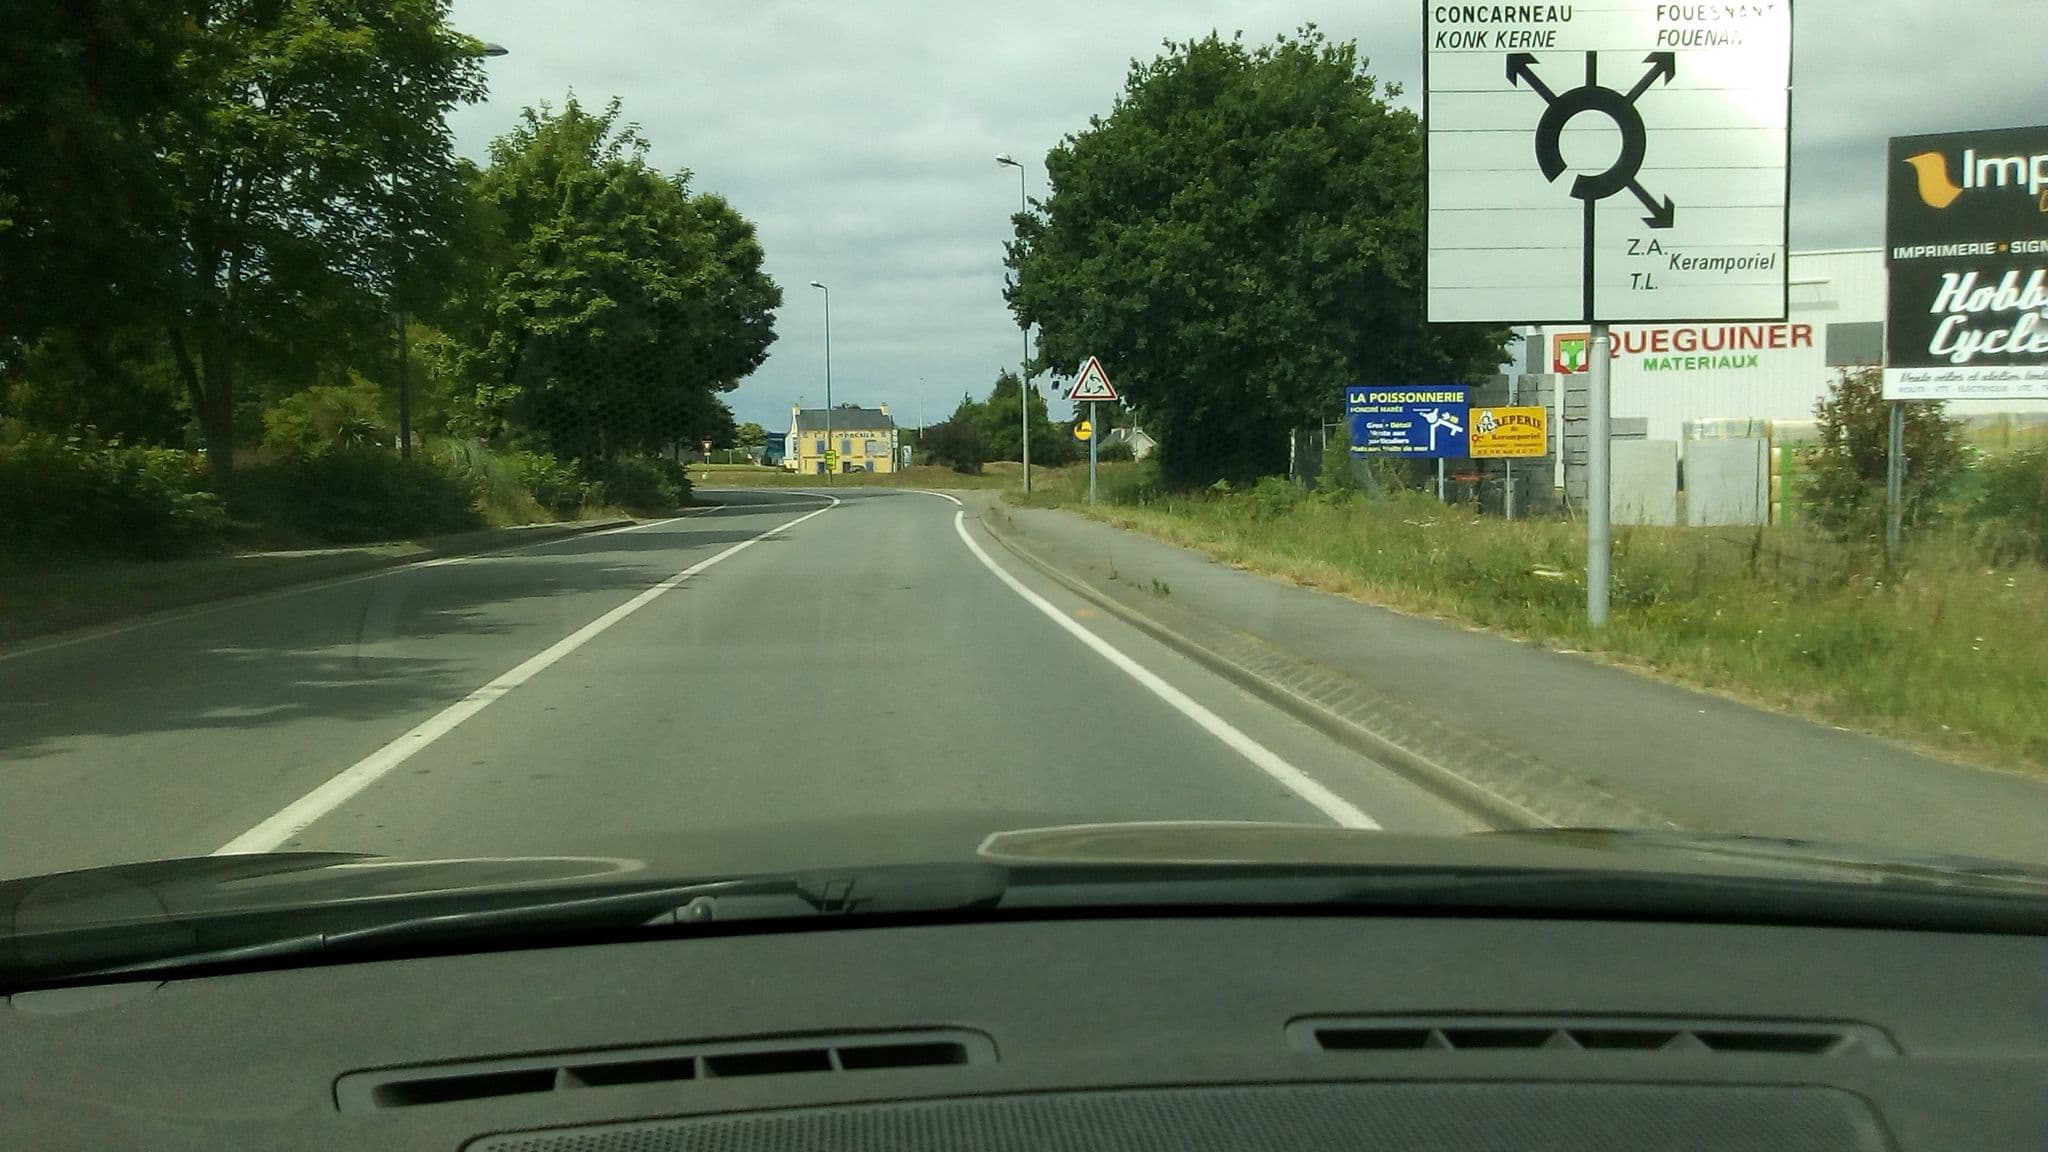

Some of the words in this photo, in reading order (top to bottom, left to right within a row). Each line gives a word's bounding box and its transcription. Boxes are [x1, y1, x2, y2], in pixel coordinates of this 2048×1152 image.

[1435, 5, 1573, 24] CONCARNEAU
[1435, 30, 1489, 49] KONK
[1494, 30, 1558, 48] KERNE
[1627, 238, 1668, 256] Z.A.
[1669, 252, 1777, 275] Keramporiel
[1893, 242, 1997, 260] IMPRIMERIE
[1630, 272, 1659, 291] T.L.
[1608, 323, 1814, 359] QUEGUINER
[1643, 354, 1760, 372] MATERIAUX
[1350, 393, 1367, 404] LA
[1369, 392, 1465, 404] POISSONNERIE
